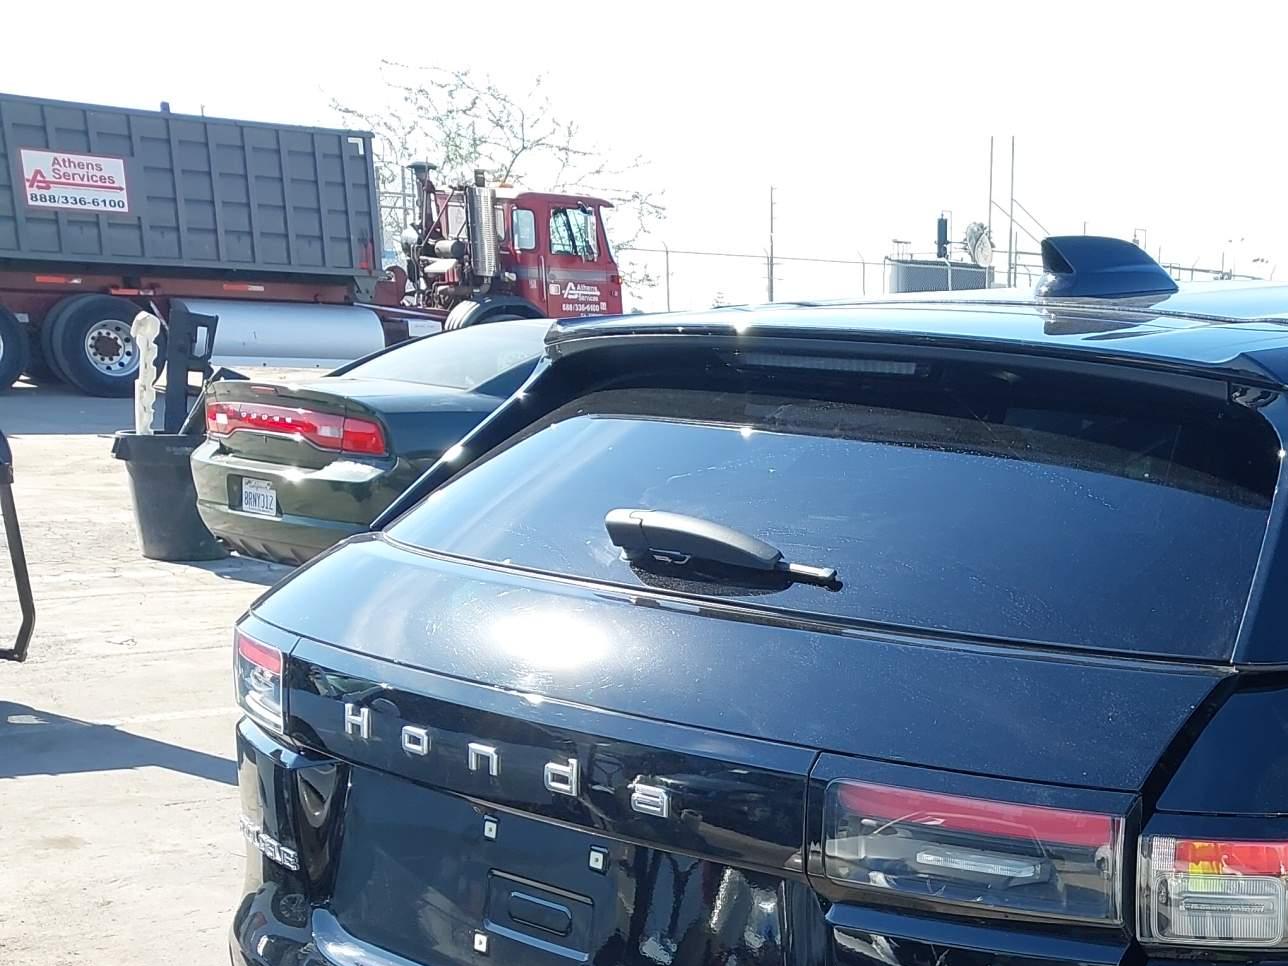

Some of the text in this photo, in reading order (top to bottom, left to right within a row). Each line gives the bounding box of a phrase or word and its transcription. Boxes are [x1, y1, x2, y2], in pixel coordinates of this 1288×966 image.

[52, 157, 103, 172] Athens
[52, 168, 116, 184] Services
[30, 193, 125, 209] 888/336-6100
[344, 702, 670, 819] Honda
